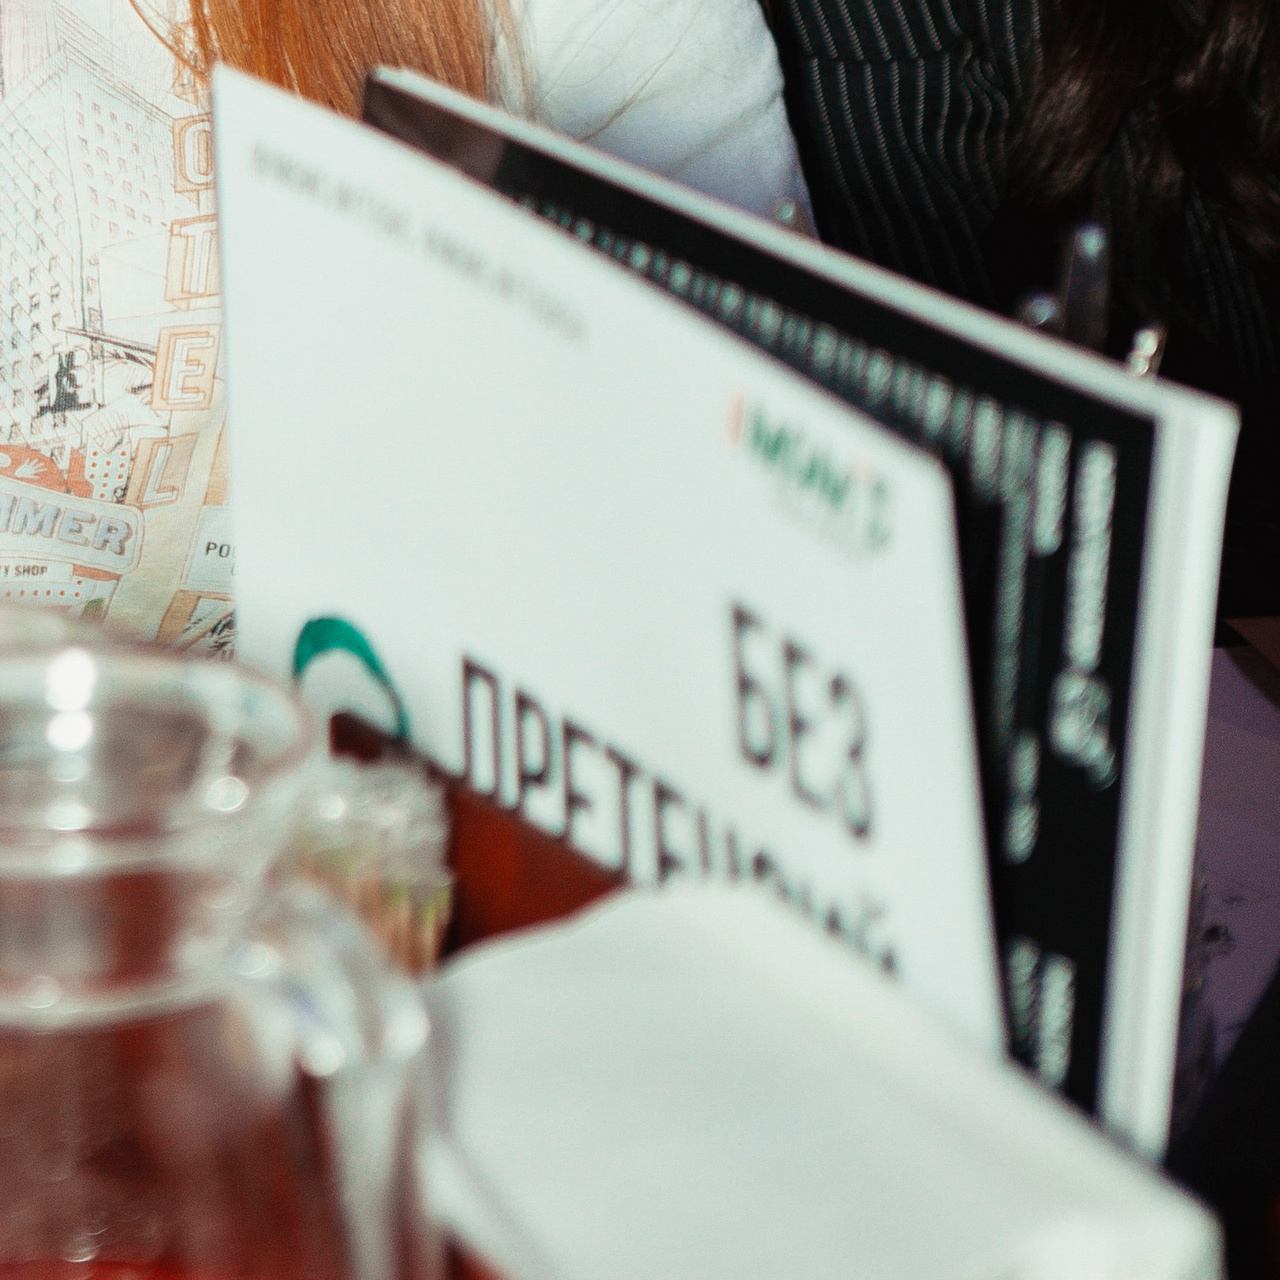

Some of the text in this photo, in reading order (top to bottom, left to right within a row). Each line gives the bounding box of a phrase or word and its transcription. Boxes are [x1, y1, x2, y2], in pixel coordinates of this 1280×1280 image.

[205, 540, 236, 560] PO
[14, 564, 49, 579] SHOP
[730, 600, 873, 842] БЕЗ
